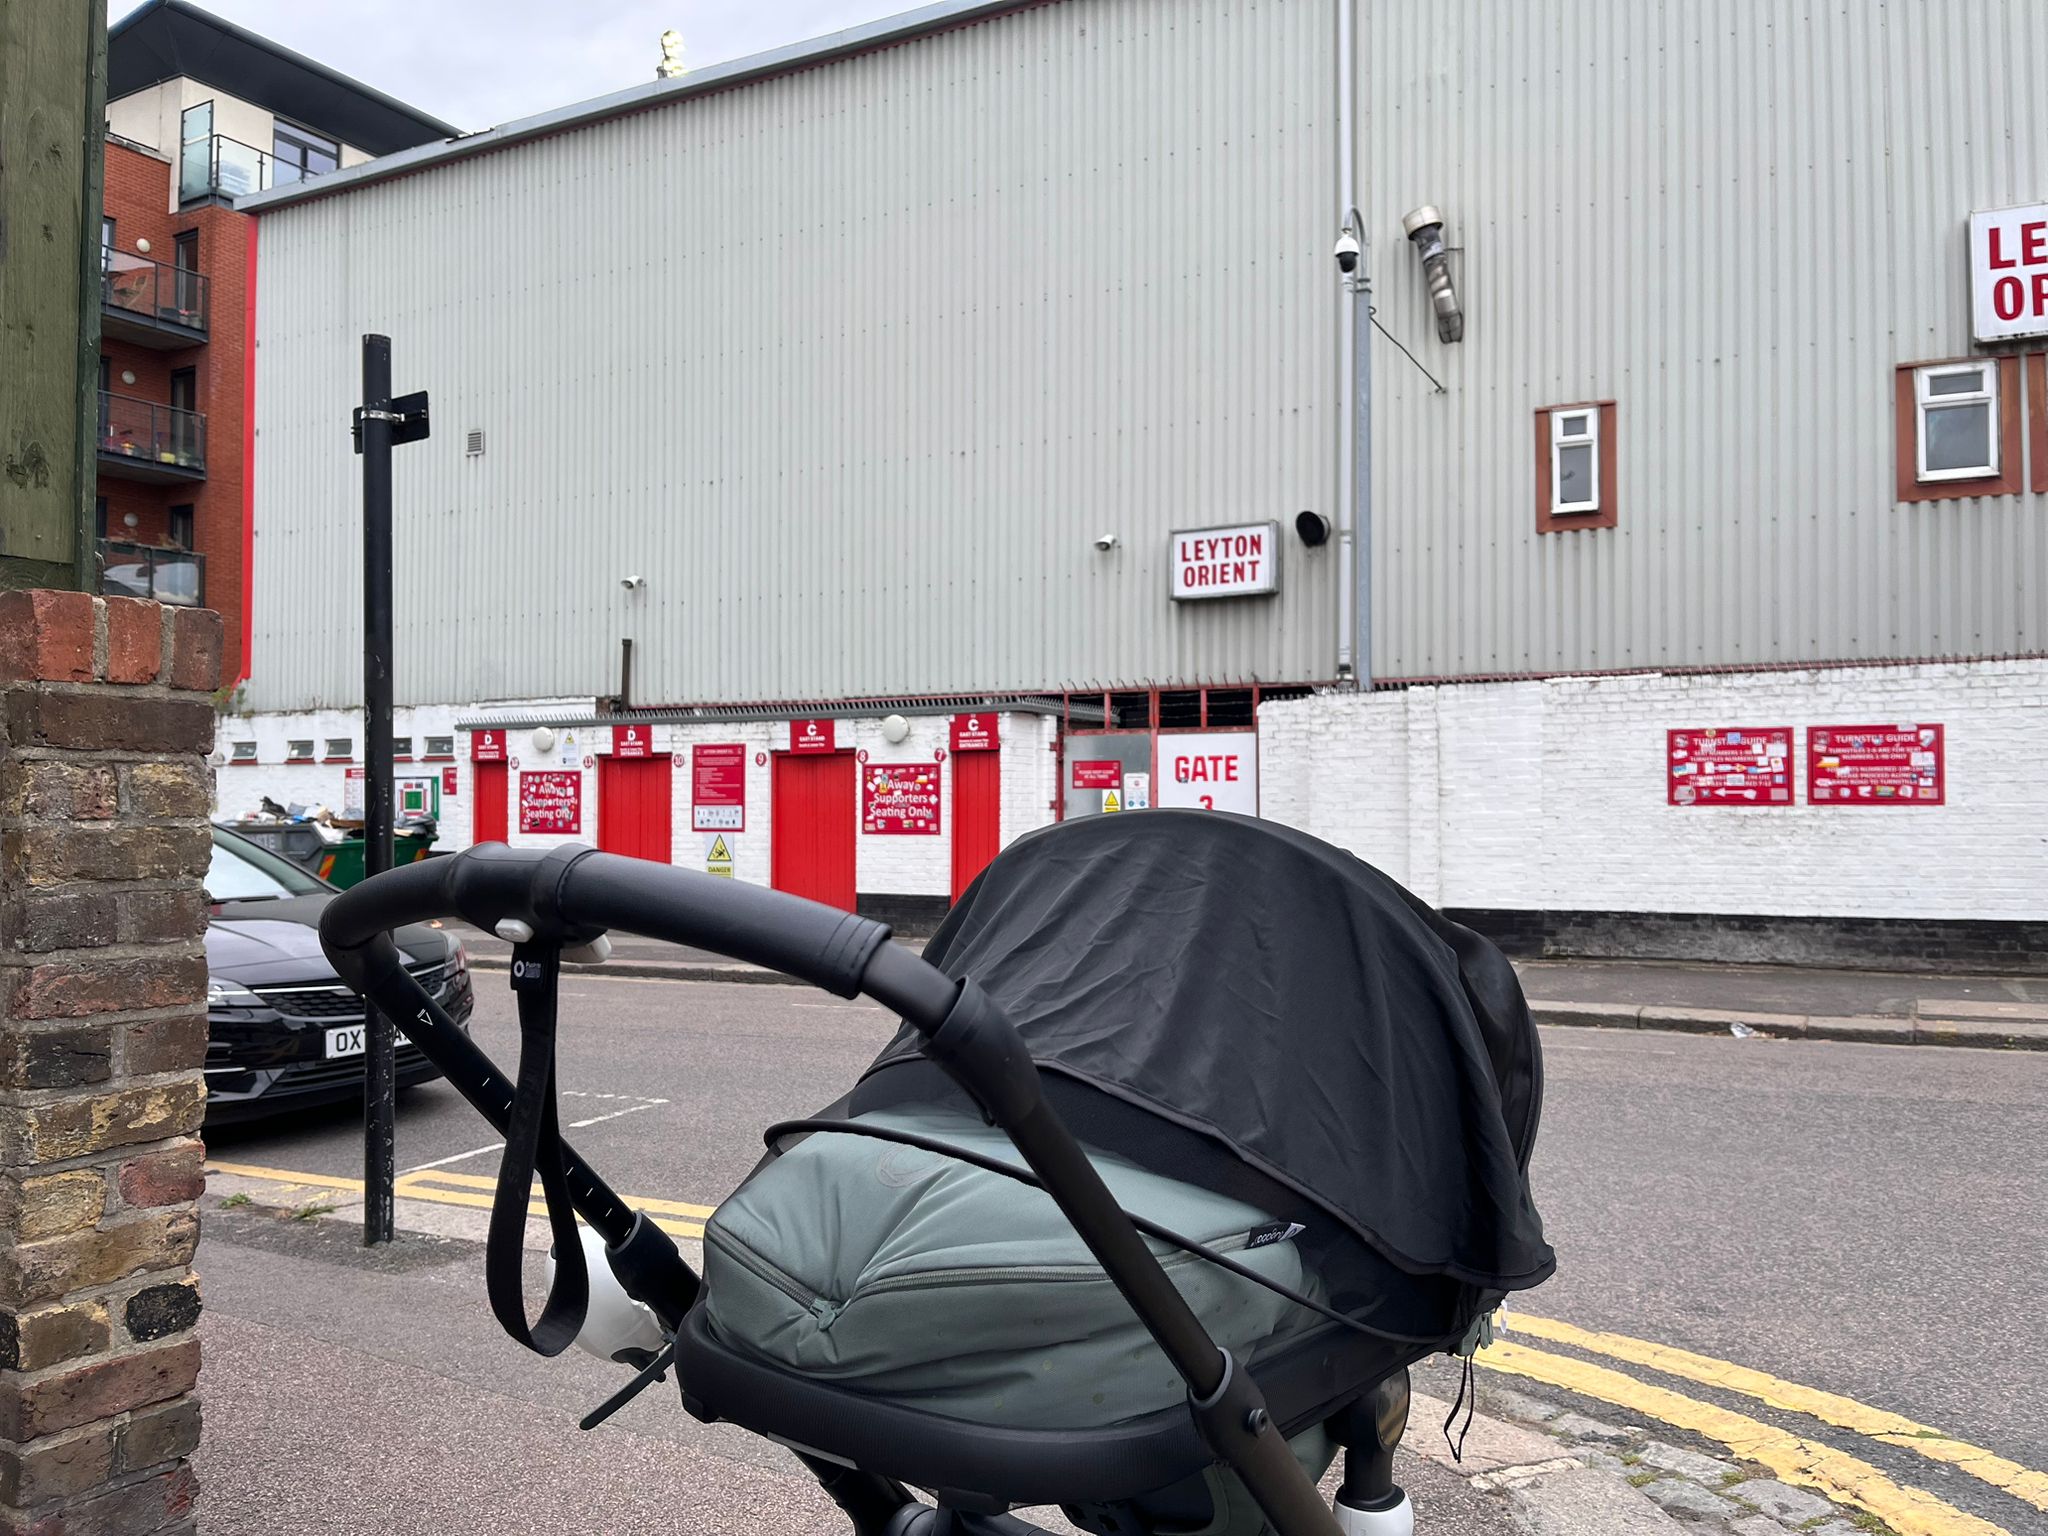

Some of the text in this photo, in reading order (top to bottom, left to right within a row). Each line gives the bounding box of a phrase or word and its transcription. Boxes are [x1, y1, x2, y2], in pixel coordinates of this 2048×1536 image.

[1989, 221, 2048, 270] LE
[1182, 534, 1262, 562] LEYTON
[1183, 560, 1260, 587] ORIENT
[807, 724, 817, 736] C
[968, 719, 979, 731] C
[484, 734, 493, 745] D
[627, 730, 636, 740] D
[1885, 733, 1916, 742] GUIDE
[674, 755, 684, 766] 10
[758, 754, 764, 765] 9
[860, 751, 866, 762] 8
[937, 750, 943, 761] 7
[584, 757, 592, 767] 11
[1175, 755, 1238, 782] GATE
[887, 780, 914, 791] Away
[528, 798, 570, 808] Supporters
[873, 793, 928, 805] Supporters
[526, 808, 554, 820] Seating
[870, 806, 906, 819] Seating
